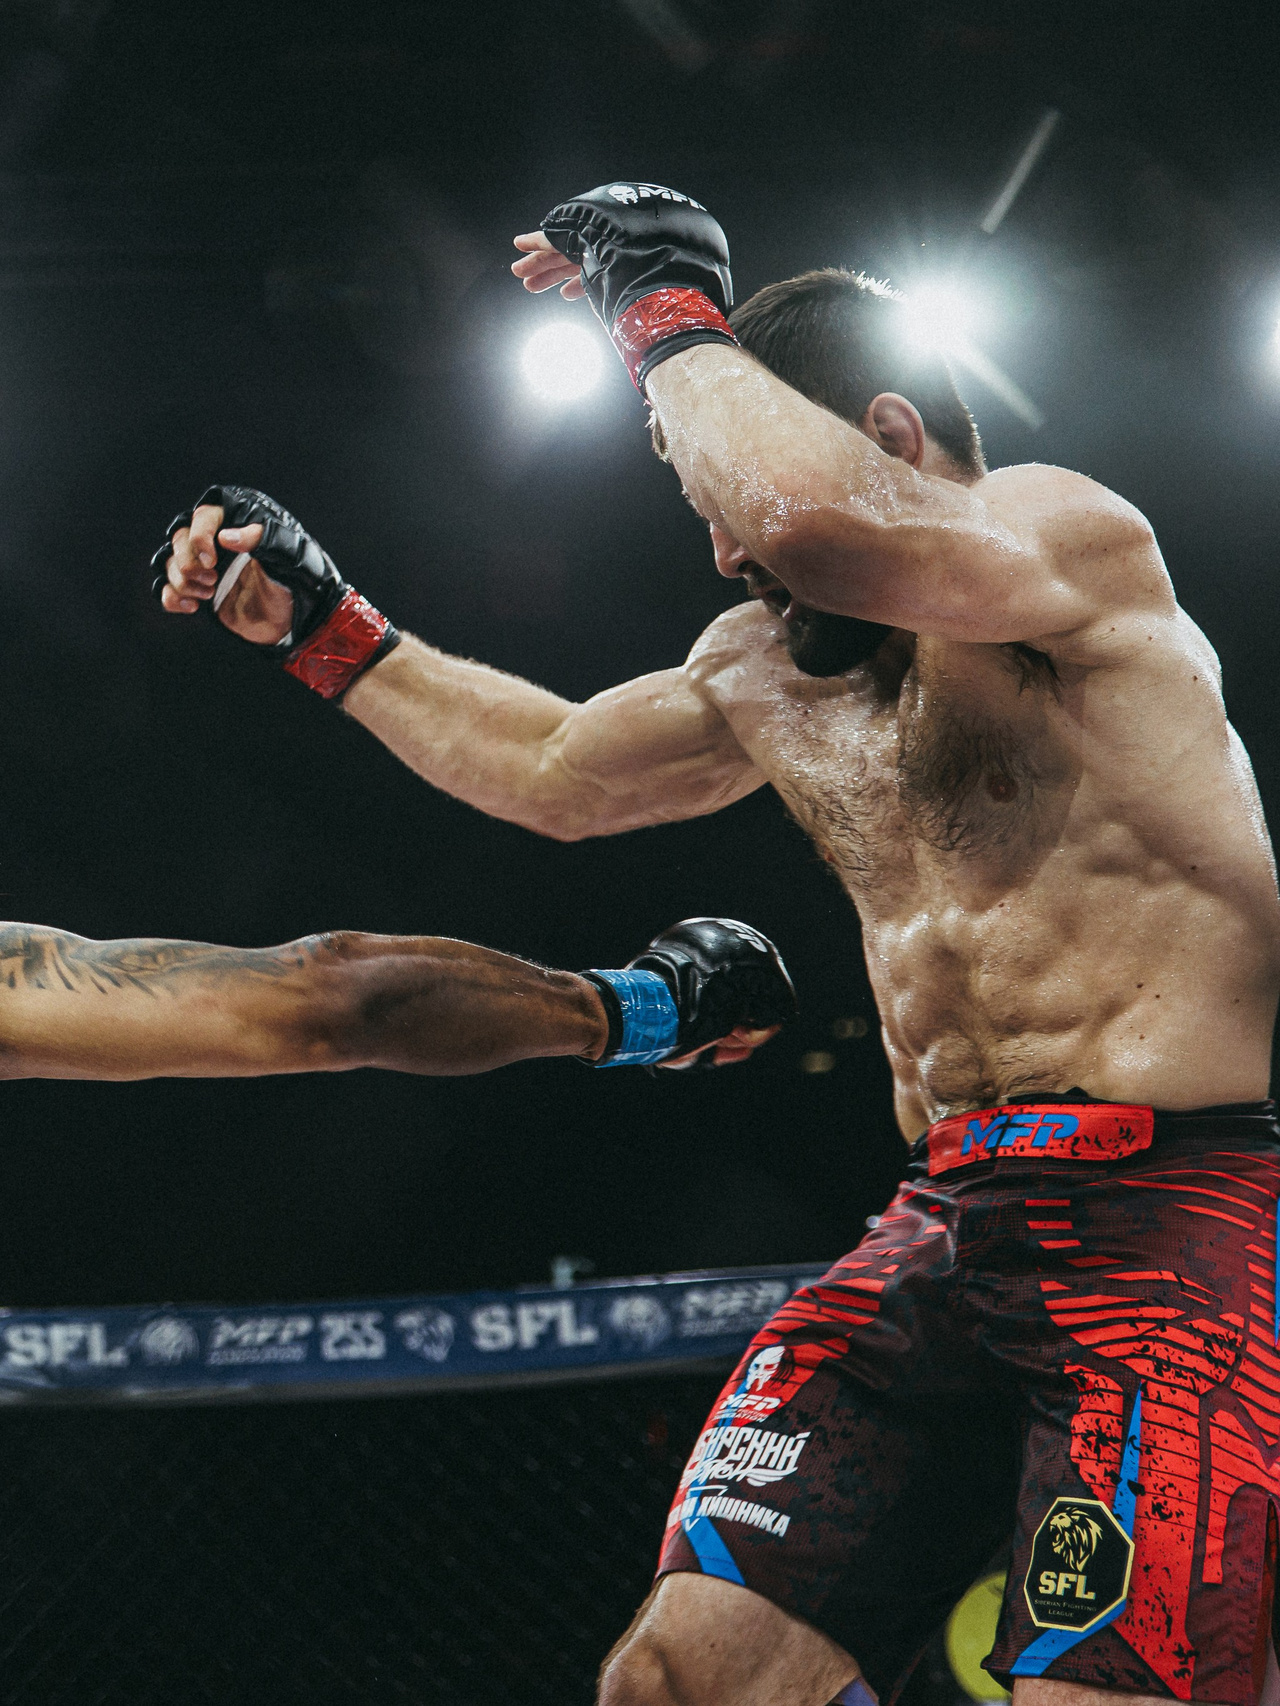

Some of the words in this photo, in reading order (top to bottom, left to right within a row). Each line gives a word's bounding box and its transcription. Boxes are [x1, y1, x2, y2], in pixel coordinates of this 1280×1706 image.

[961, 1113, 1079, 1155] MFP
[471, 1300, 599, 1350] SFL
[4, 1323, 129, 1366] SFL
[720, 1393, 781, 1411] MFP
[1038, 1570, 1096, 1600] SFL
[1048, 1609, 1074, 1617] LEAGUE
